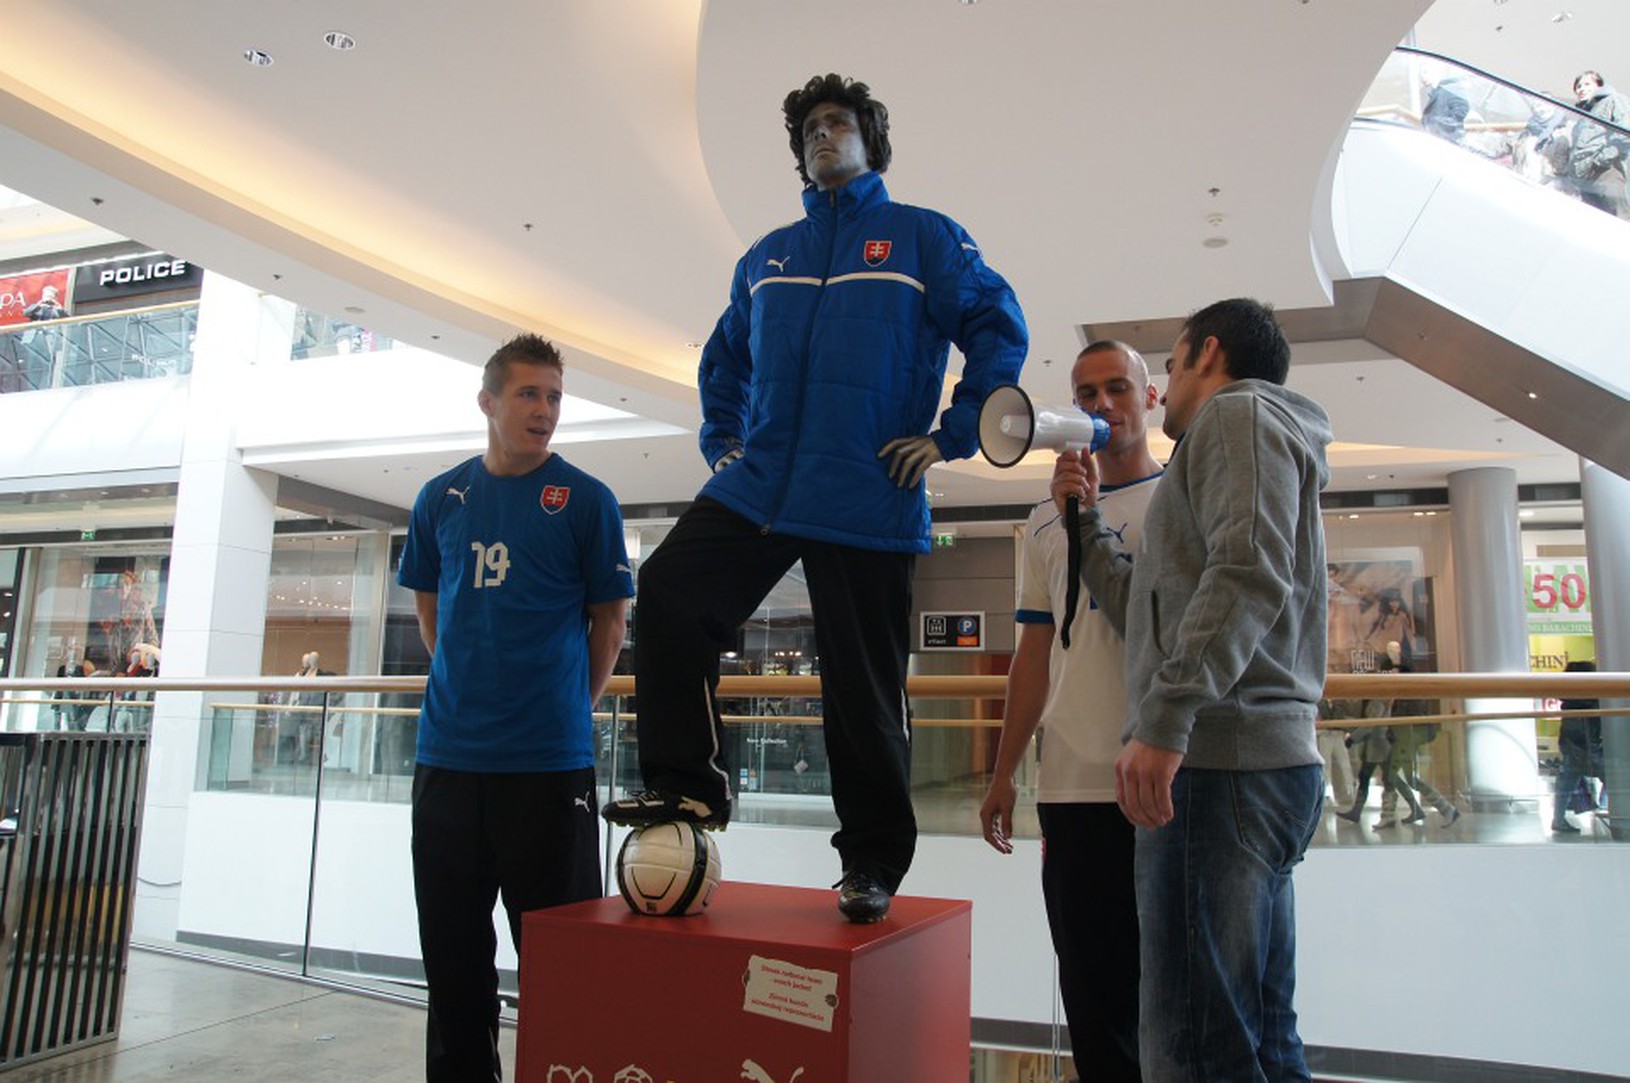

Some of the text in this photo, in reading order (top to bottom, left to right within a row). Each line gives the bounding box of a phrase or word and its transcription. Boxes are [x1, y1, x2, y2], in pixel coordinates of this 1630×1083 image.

[100, 260, 186, 286] POLICE
[471, 541, 511, 588] 19
[1533, 573, 1586, 609] 50
